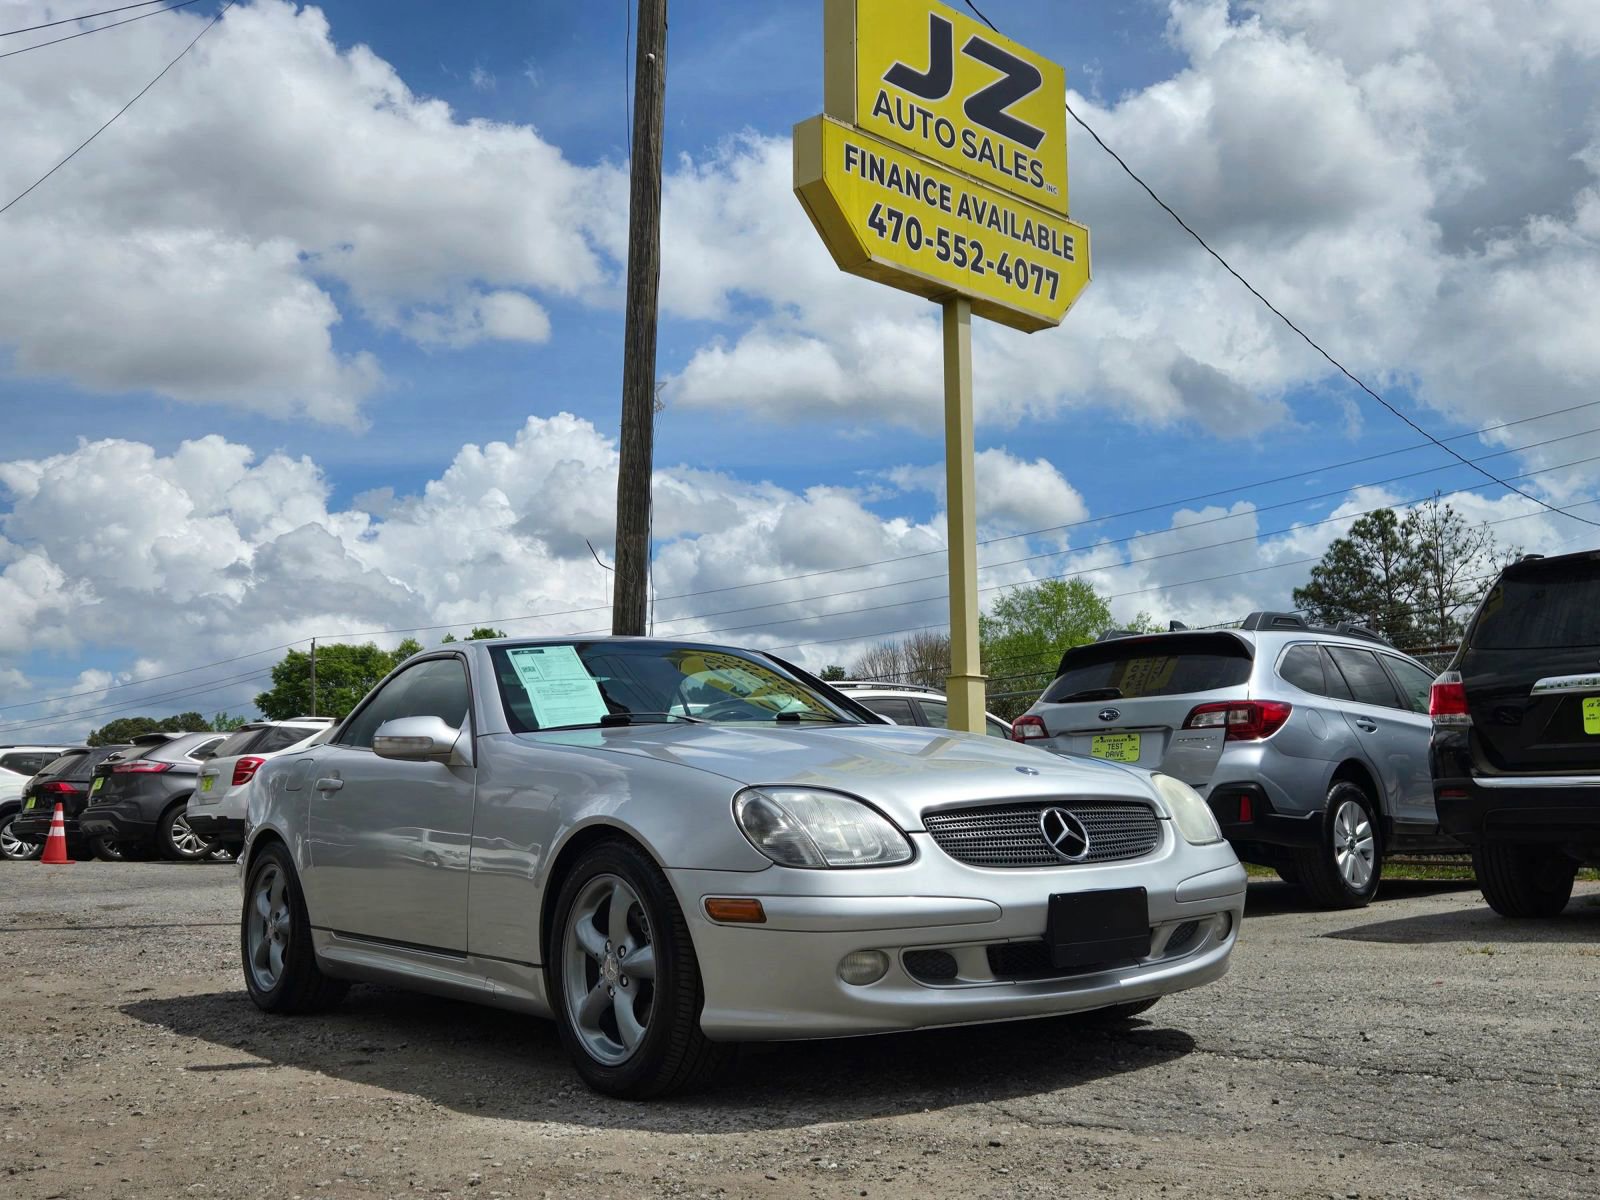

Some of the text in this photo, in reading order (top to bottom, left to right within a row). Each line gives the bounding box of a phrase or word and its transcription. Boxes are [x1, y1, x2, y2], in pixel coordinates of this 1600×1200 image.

[883, 13, 1046, 151] JZ
[872, 90, 1057, 195] AUTO SALES INC
[845, 144, 1075, 261] FINANCE AVAILABLE
[868, 204, 1060, 300] 470-552-4077
[1105, 750, 1125, 758] DRIVE
[1107, 742, 1123, 750] TEST
